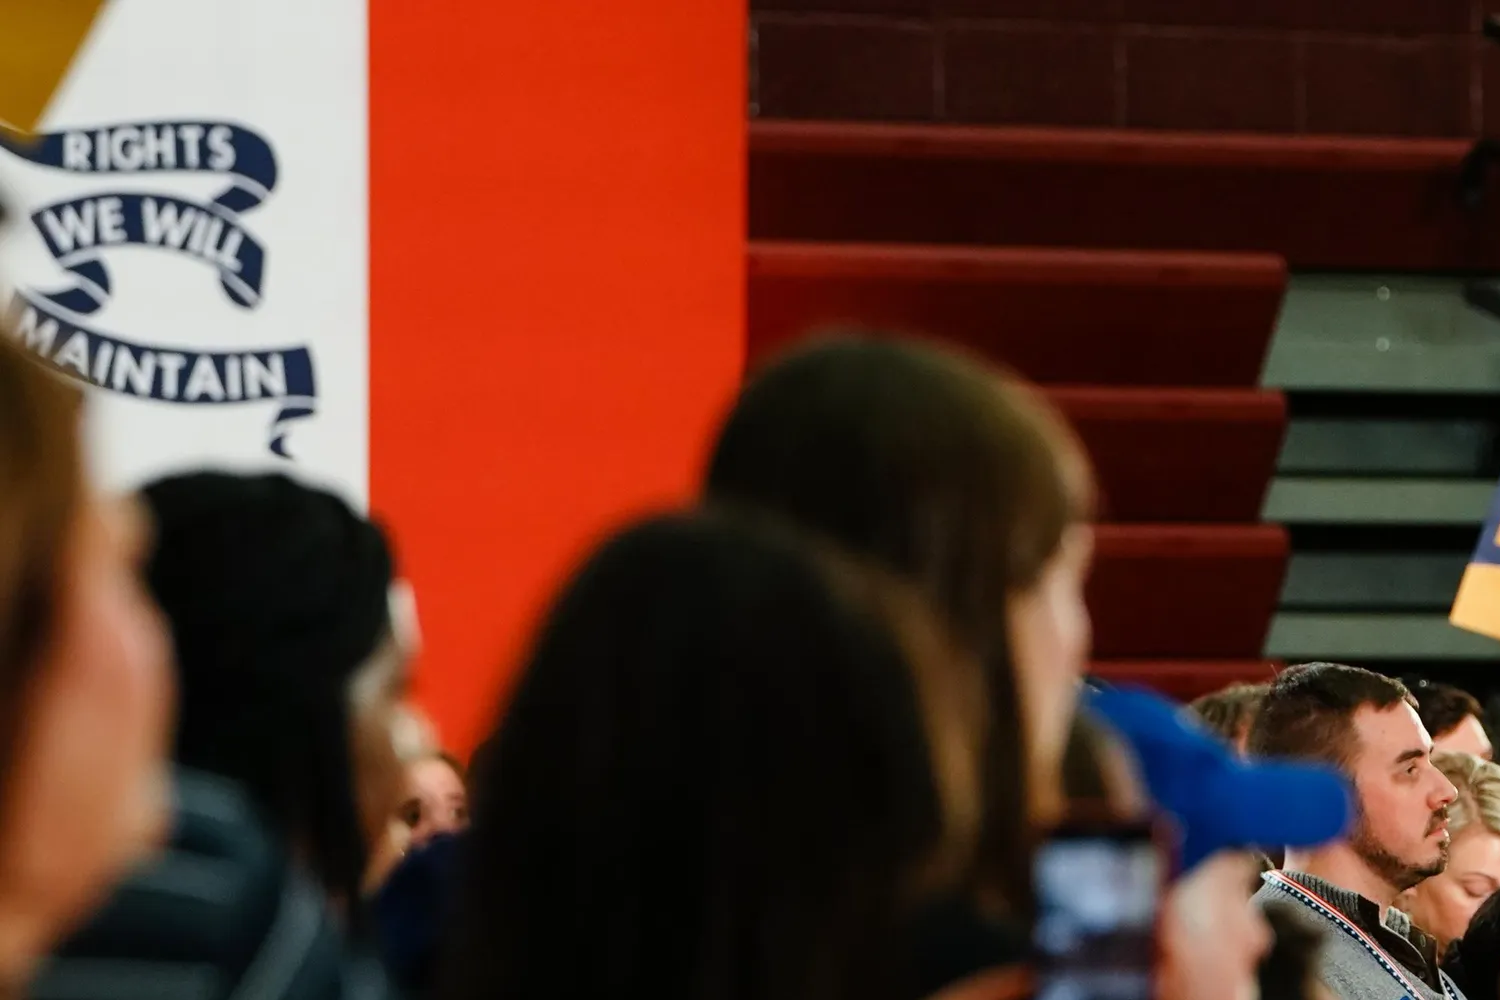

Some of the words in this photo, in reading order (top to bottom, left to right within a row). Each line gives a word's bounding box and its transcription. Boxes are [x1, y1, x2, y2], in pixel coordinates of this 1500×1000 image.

[62, 124, 236, 172] RIGHTS
[42, 197, 128, 253] WE
[142, 196, 245, 273] WILL
[15, 307, 288, 401] MAINTAIN
